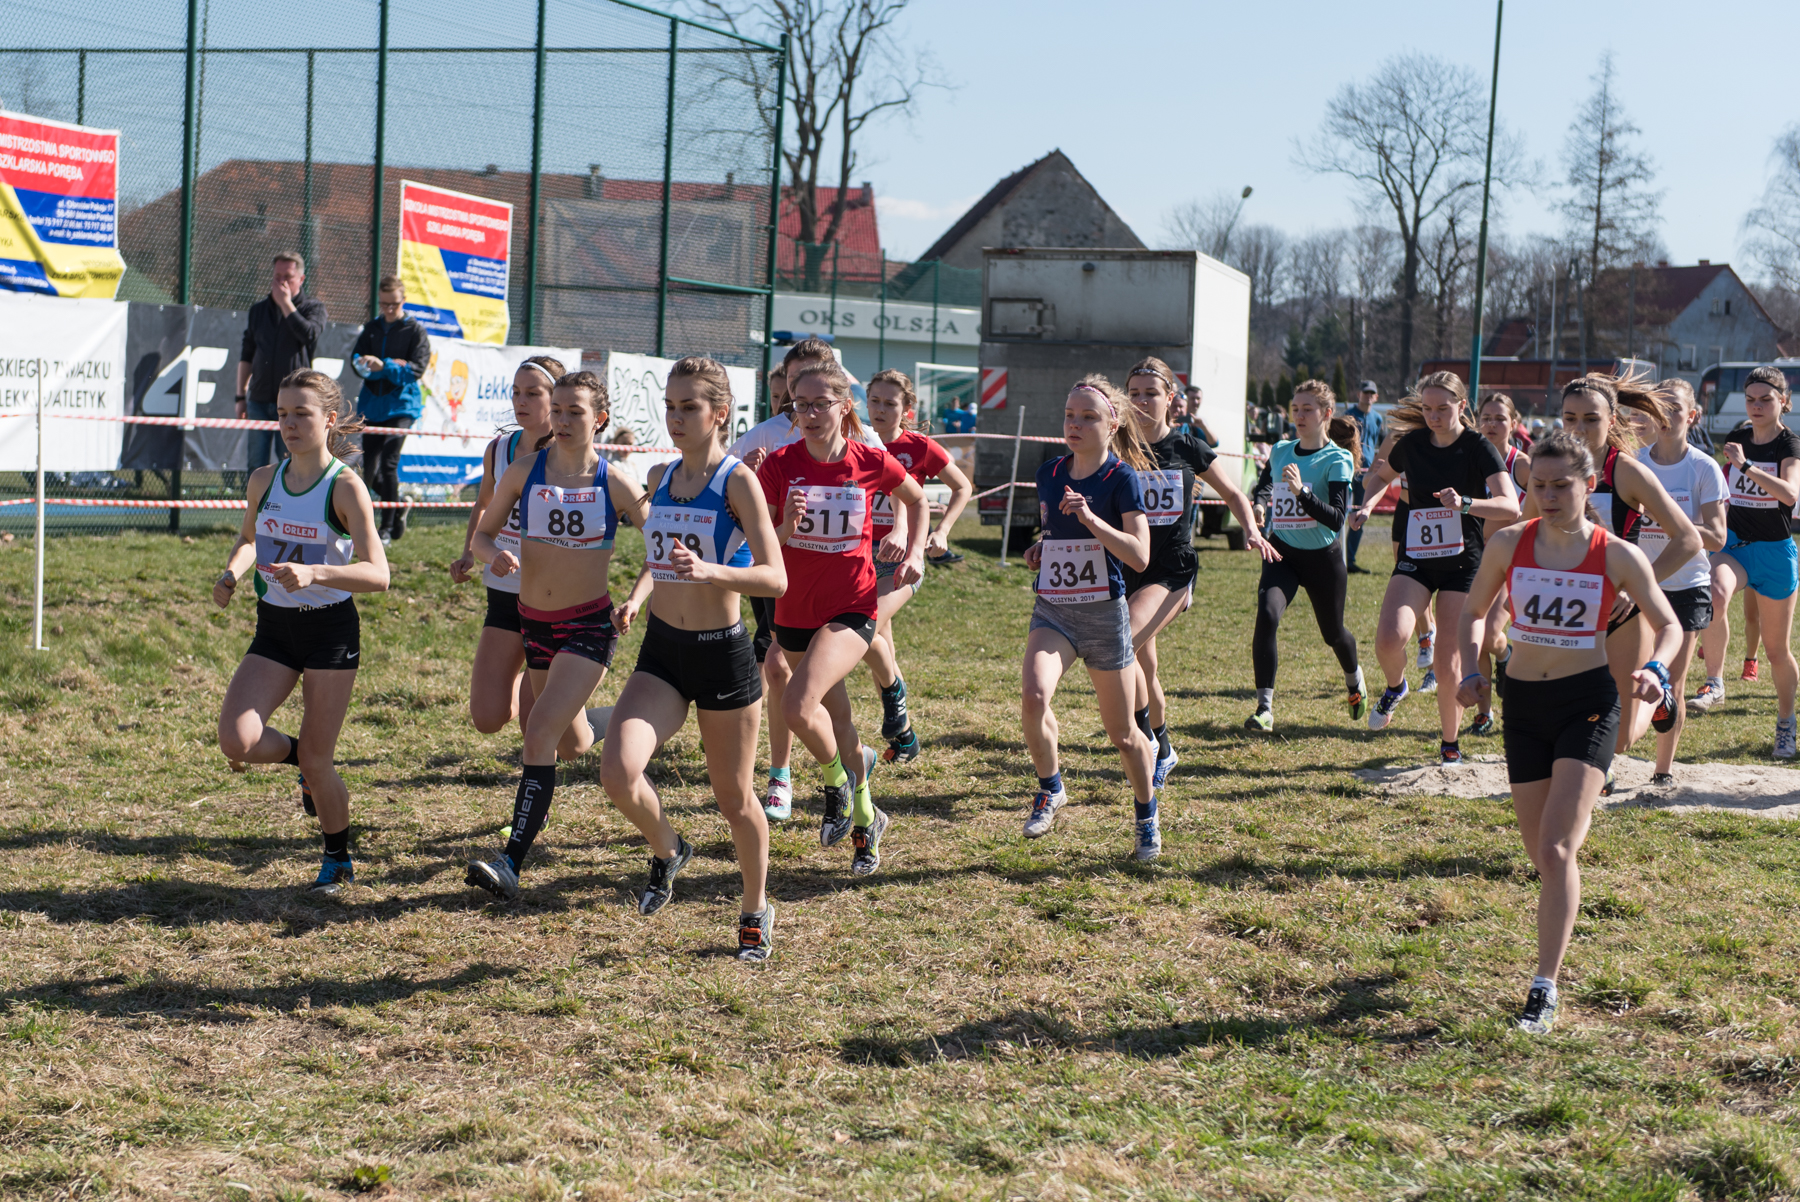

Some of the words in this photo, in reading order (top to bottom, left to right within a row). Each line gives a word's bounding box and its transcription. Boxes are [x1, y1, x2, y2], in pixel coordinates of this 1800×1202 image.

[799, 309, 856, 328] OKS
[873, 314, 960, 335] OLSZA
[563, 493, 595, 503] ORLEN
[852, 493, 863, 501] LUG
[700, 515, 713, 524] LUG
[796, 508, 850, 535] 511
[1427, 511, 1452, 519] ORLEN
[547, 508, 585, 536] 88
[284, 524, 316, 537] ORLEN
[1420, 523, 1444, 545] 81
[273, 540, 305, 564] 74
[651, 530, 704, 561] 378
[799, 541, 829, 551] OLSZYNA
[831, 543, 847, 551] 2019
[1090, 543, 1101, 551] LUG
[1049, 560, 1098, 588] 334
[1586, 581, 1600, 590] LUG
[1049, 596, 1078, 604] OLSZYNA
[1079, 595, 1096, 603] 2019
[574, 602, 600, 615] ELBRUS
[1523, 594, 1587, 628] 442
[697, 631, 724, 642] NIKE
[724, 623, 741, 638] PRO
[1521, 634, 1557, 646] OLSZYNA
[1560, 638, 1580, 647] 2019
[510, 778, 542, 843] kalenji
